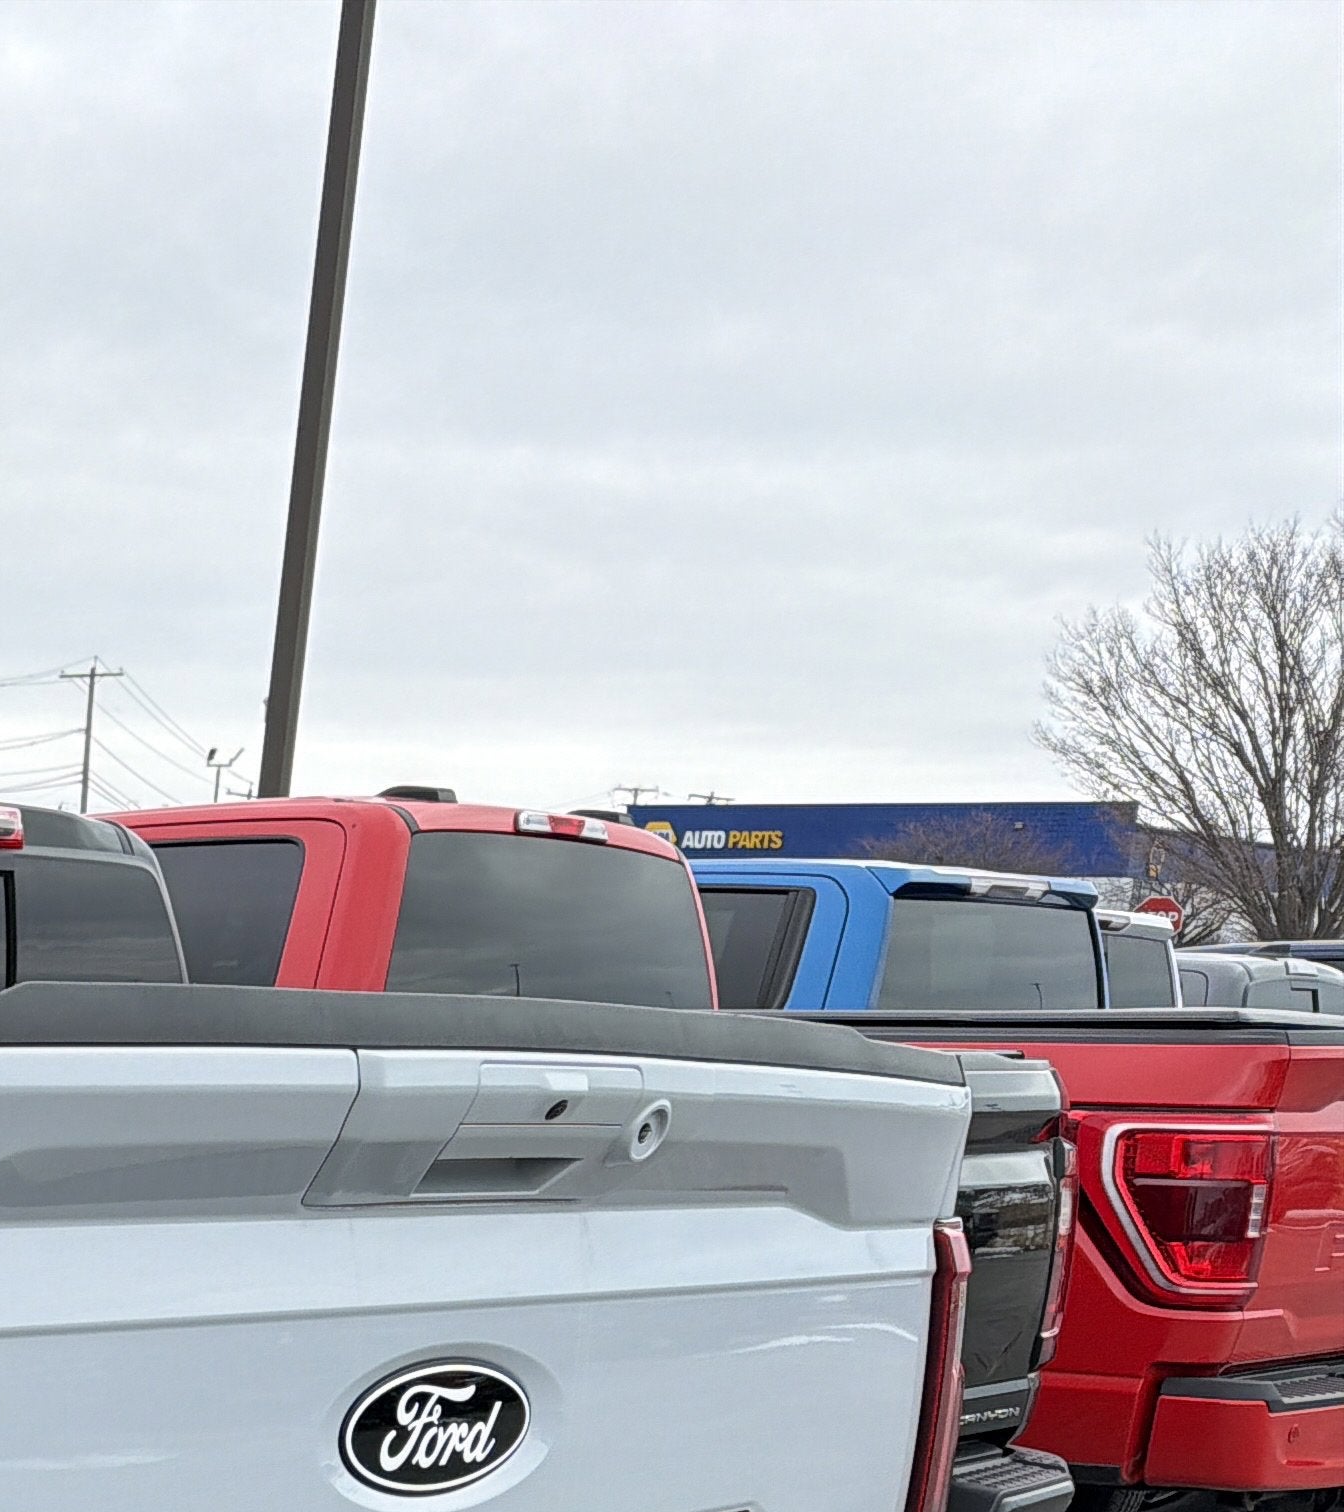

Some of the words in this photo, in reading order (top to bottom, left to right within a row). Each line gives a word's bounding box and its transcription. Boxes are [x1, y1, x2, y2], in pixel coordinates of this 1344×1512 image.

[681, 830, 727, 849] AUTO
[727, 830, 783, 849] PARTS
[379, 1383, 503, 1472] Ford
